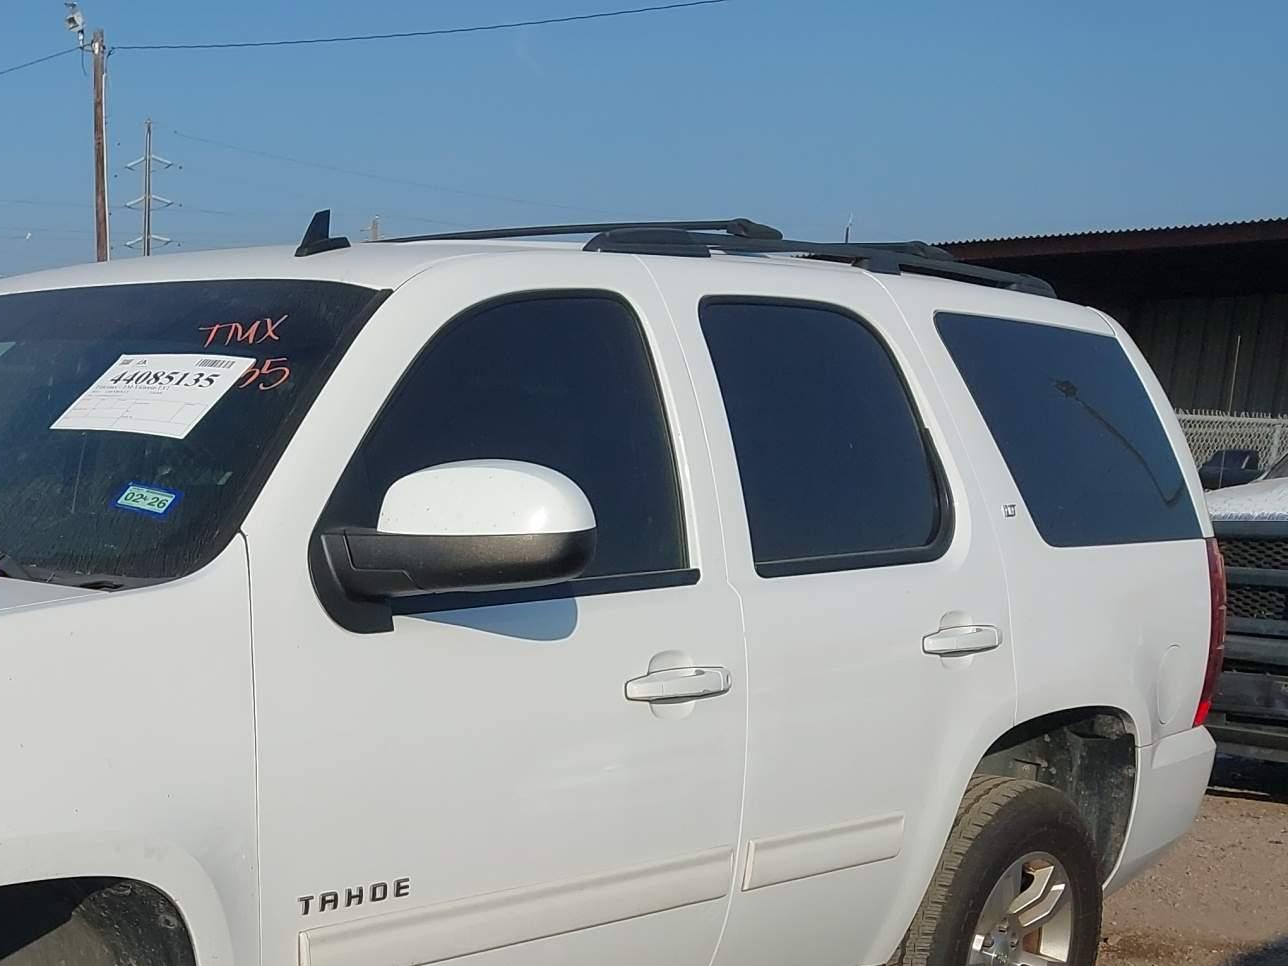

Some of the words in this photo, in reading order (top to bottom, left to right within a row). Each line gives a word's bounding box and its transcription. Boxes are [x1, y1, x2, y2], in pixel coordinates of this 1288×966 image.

[198, 314, 289, 348] TMX
[110, 370, 221, 388] 44085135
[147, 496, 169, 509] 26
[297, 877, 410, 915] TAHOE
